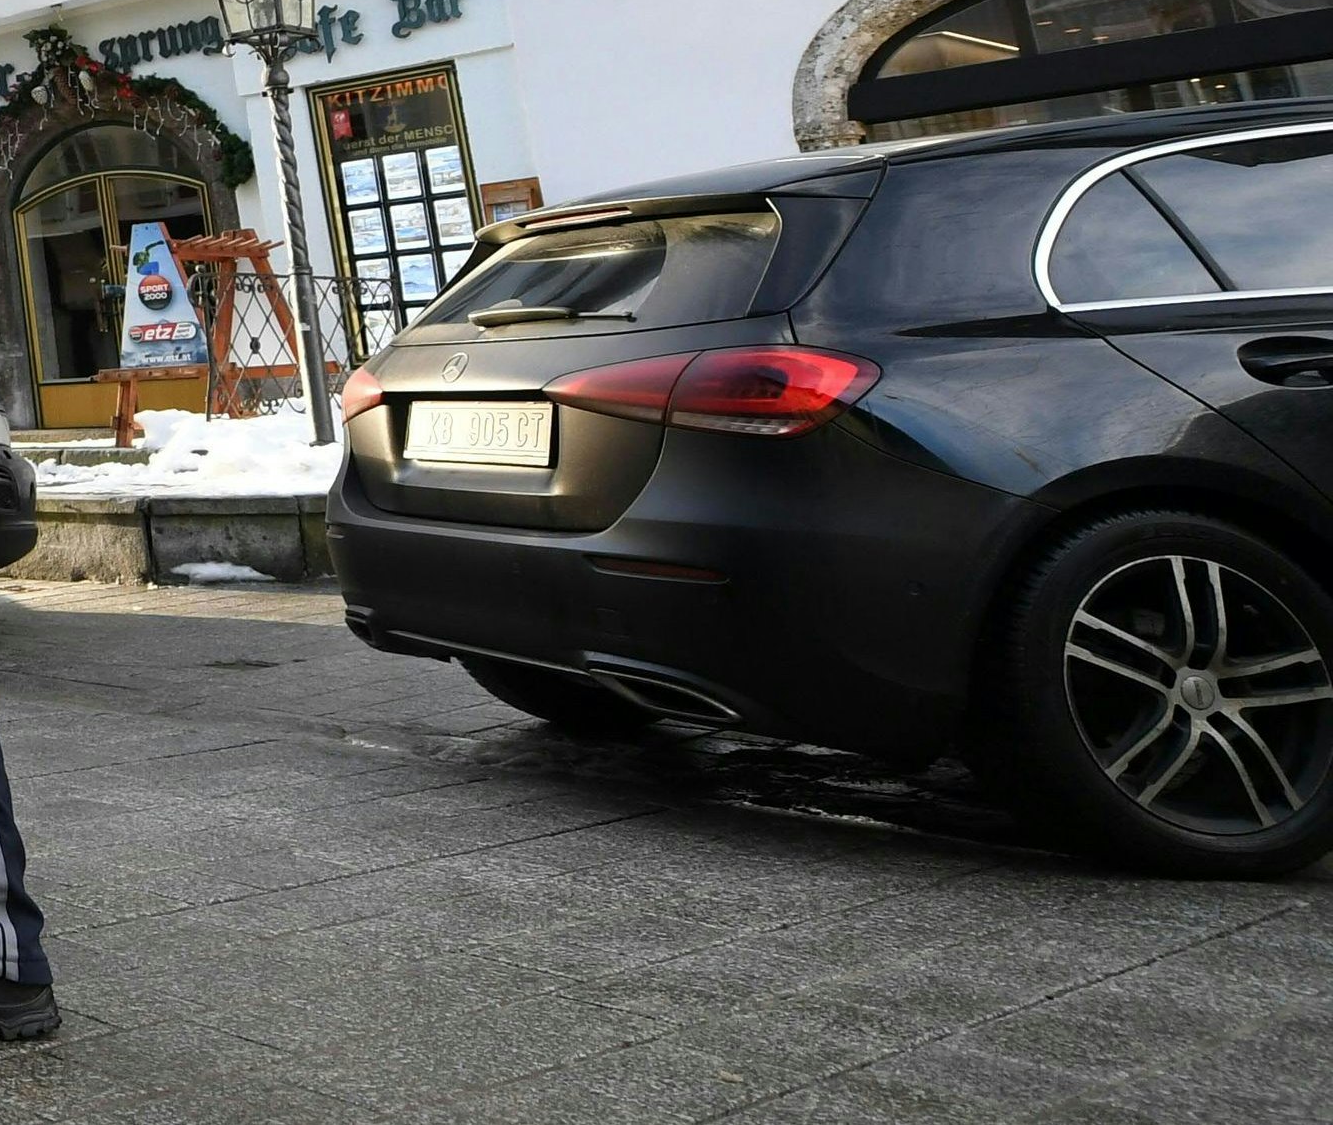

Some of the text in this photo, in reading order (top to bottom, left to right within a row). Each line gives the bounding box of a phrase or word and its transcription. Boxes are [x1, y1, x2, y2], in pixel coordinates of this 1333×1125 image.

[140, 283, 169, 293] SPORT
[144, 291, 168, 301] 2000
[144, 325, 173, 341] etz
[469, 412, 509, 447] 905
[516, 412, 545, 448] CT
